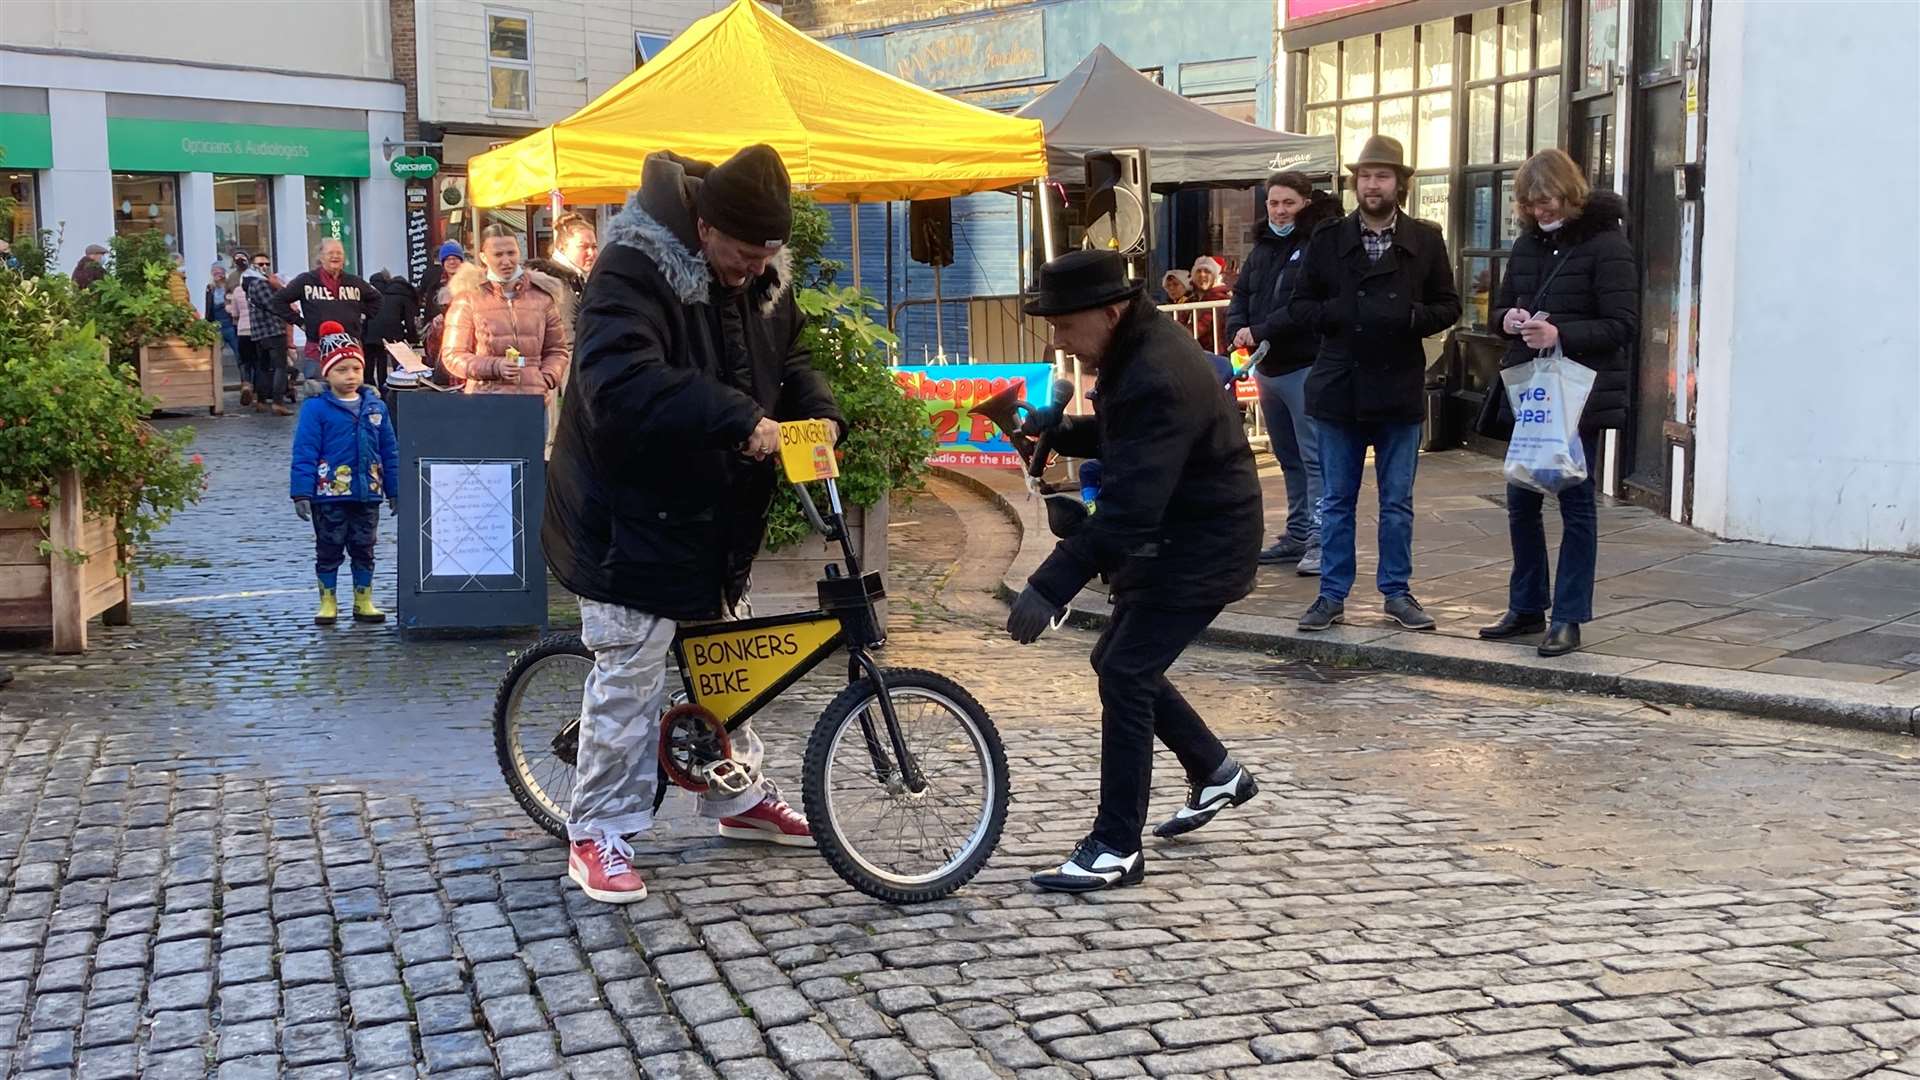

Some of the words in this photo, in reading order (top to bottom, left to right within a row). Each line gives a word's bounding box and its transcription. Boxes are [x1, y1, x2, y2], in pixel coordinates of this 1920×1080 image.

[181, 136, 233, 155] Opticians
[234, 140, 242, 154] &
[246, 140, 309, 160] Audiologists
[394, 161, 432, 173] Specsavers
[1267, 152, 1312, 170] Airwave
[1421, 194, 1449, 205] EYELASH
[960, 453, 976, 465] for
[979, 453, 999, 466] the
[694, 633, 799, 666] BONKERS
[699, 668, 751, 696] BIKE
